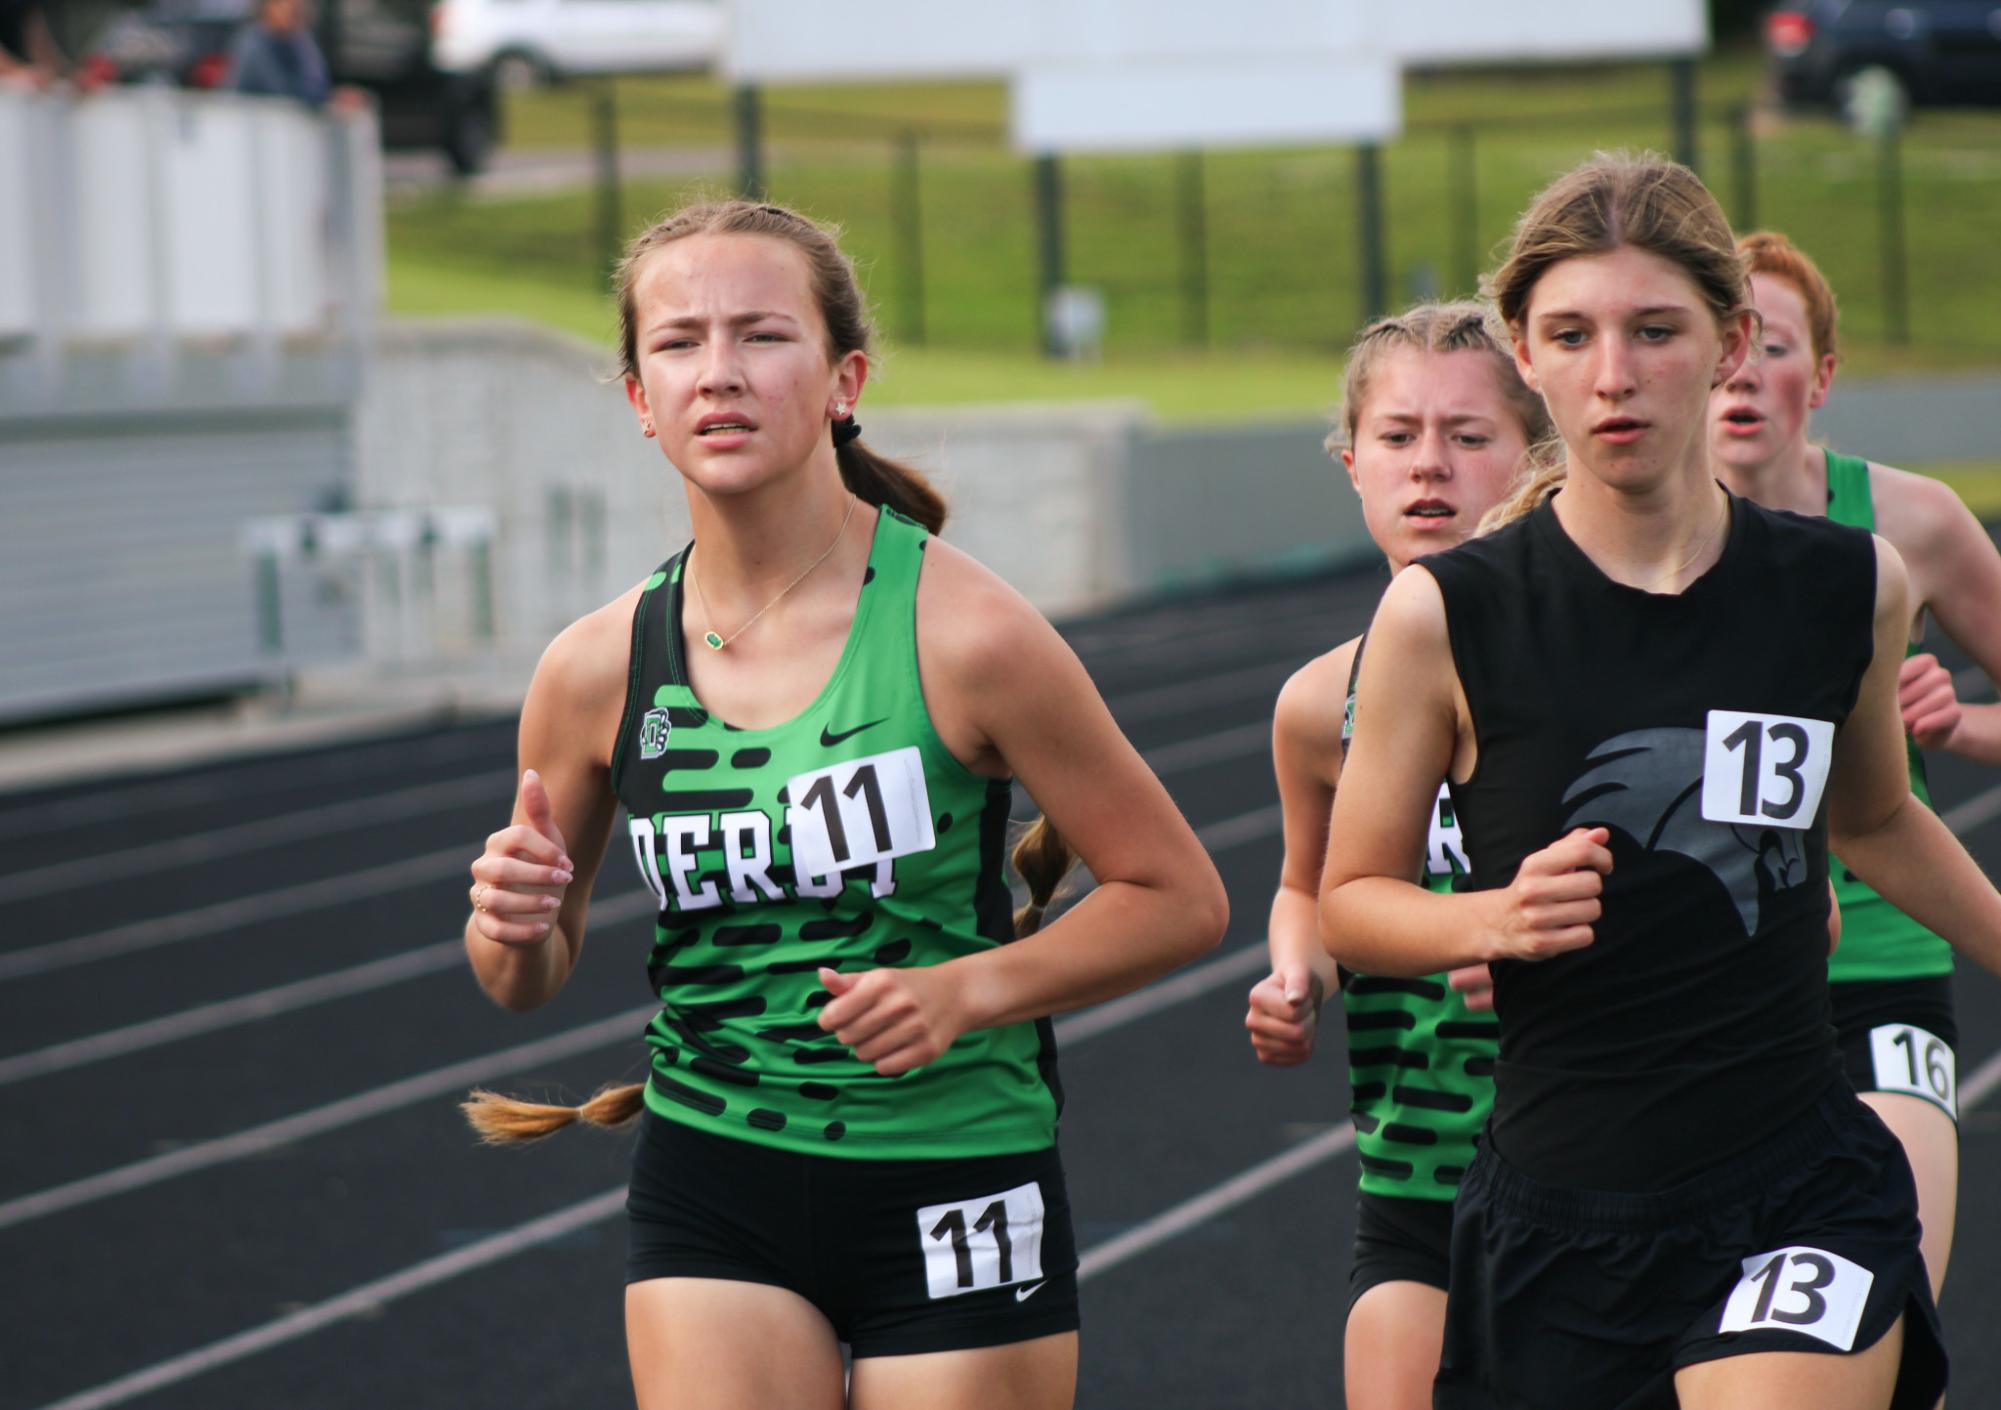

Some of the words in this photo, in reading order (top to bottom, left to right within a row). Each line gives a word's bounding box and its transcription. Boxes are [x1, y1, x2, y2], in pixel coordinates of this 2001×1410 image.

[800, 765, 892, 863] 11
[1722, 721, 1809, 819] 13
[630, 811, 896, 911] DER
[1893, 1028, 1949, 1100] 16
[930, 1200, 1013, 1287] 11
[1751, 1253, 1836, 1325] 13
